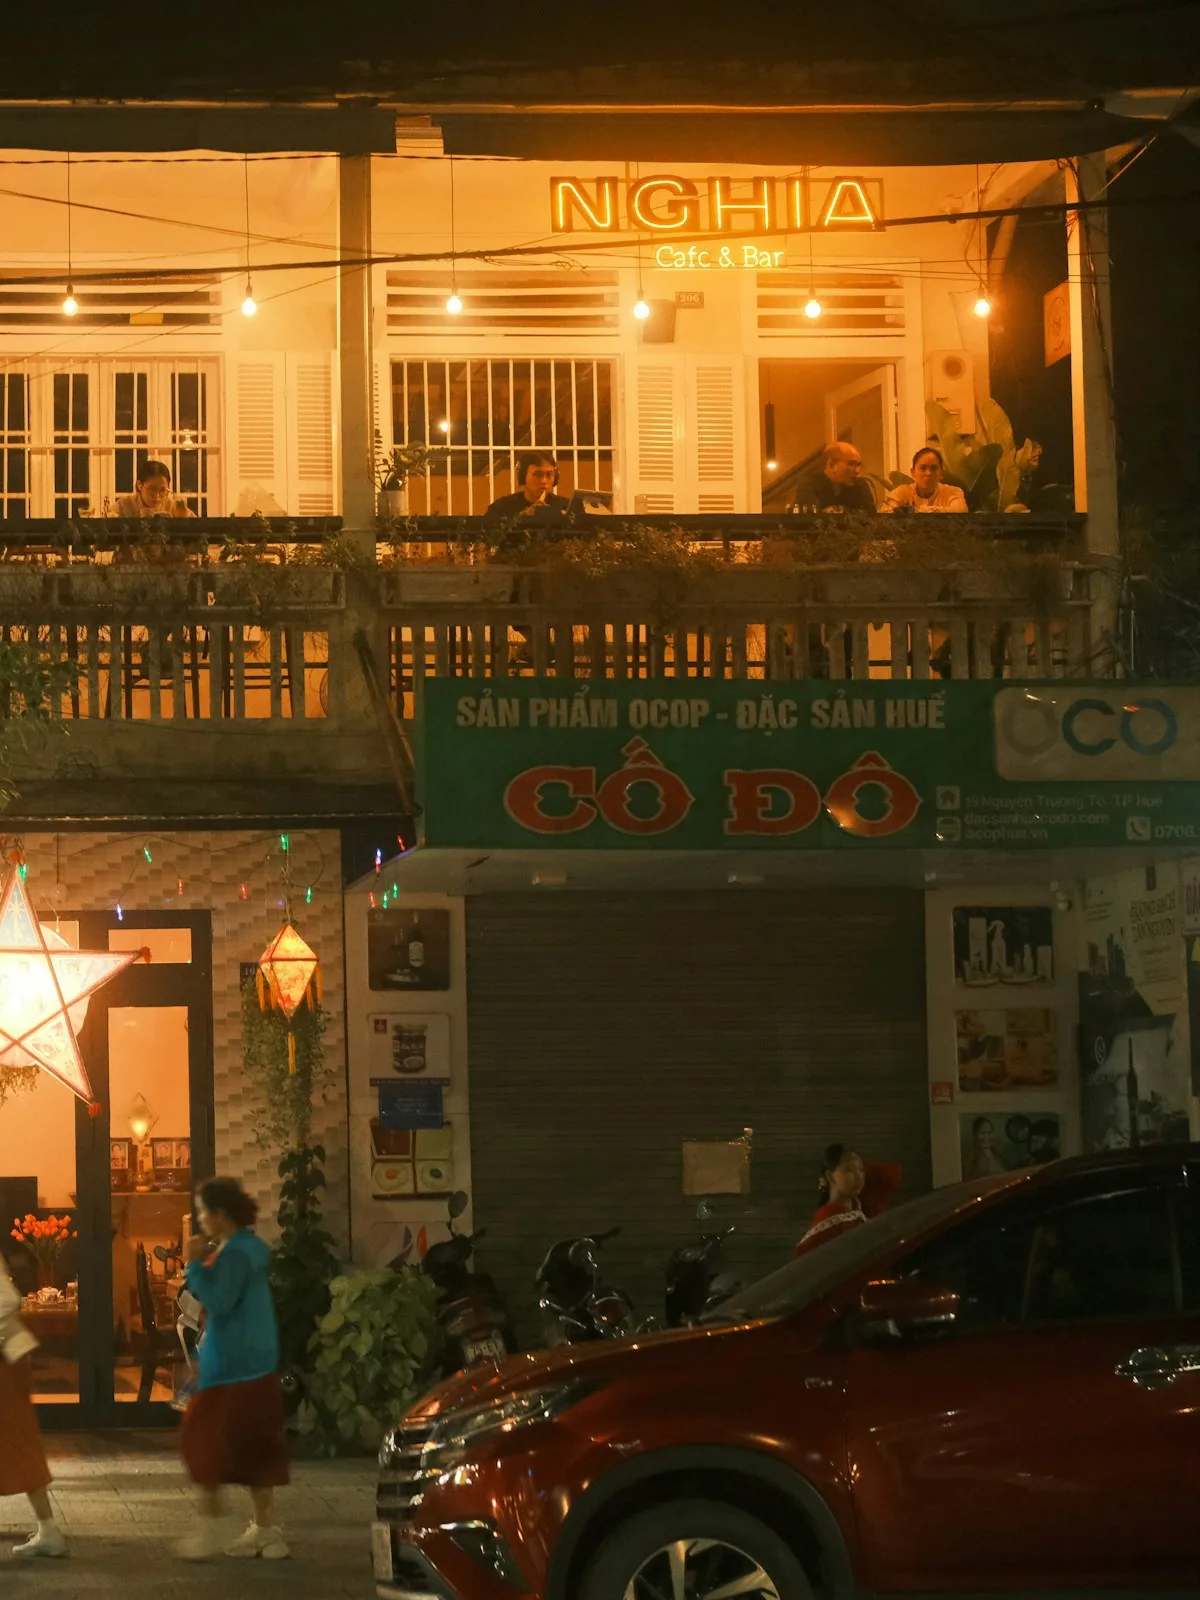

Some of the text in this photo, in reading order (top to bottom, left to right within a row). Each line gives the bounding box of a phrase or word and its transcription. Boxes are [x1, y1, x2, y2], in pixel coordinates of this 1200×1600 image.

[718, 246, 735, 267] &
[742, 245, 784, 268] Bar
[456, 687, 520, 728] SẢN
[528, 684, 618, 728] PHẨM
[628, 698, 710, 729] OCOP
[735, 693, 798, 736] ĐẶC
[810, 688, 876, 729] SẢN
[885, 689, 946, 729] HUẾ
[503, 735, 924, 837] CỐ ĐÔ
